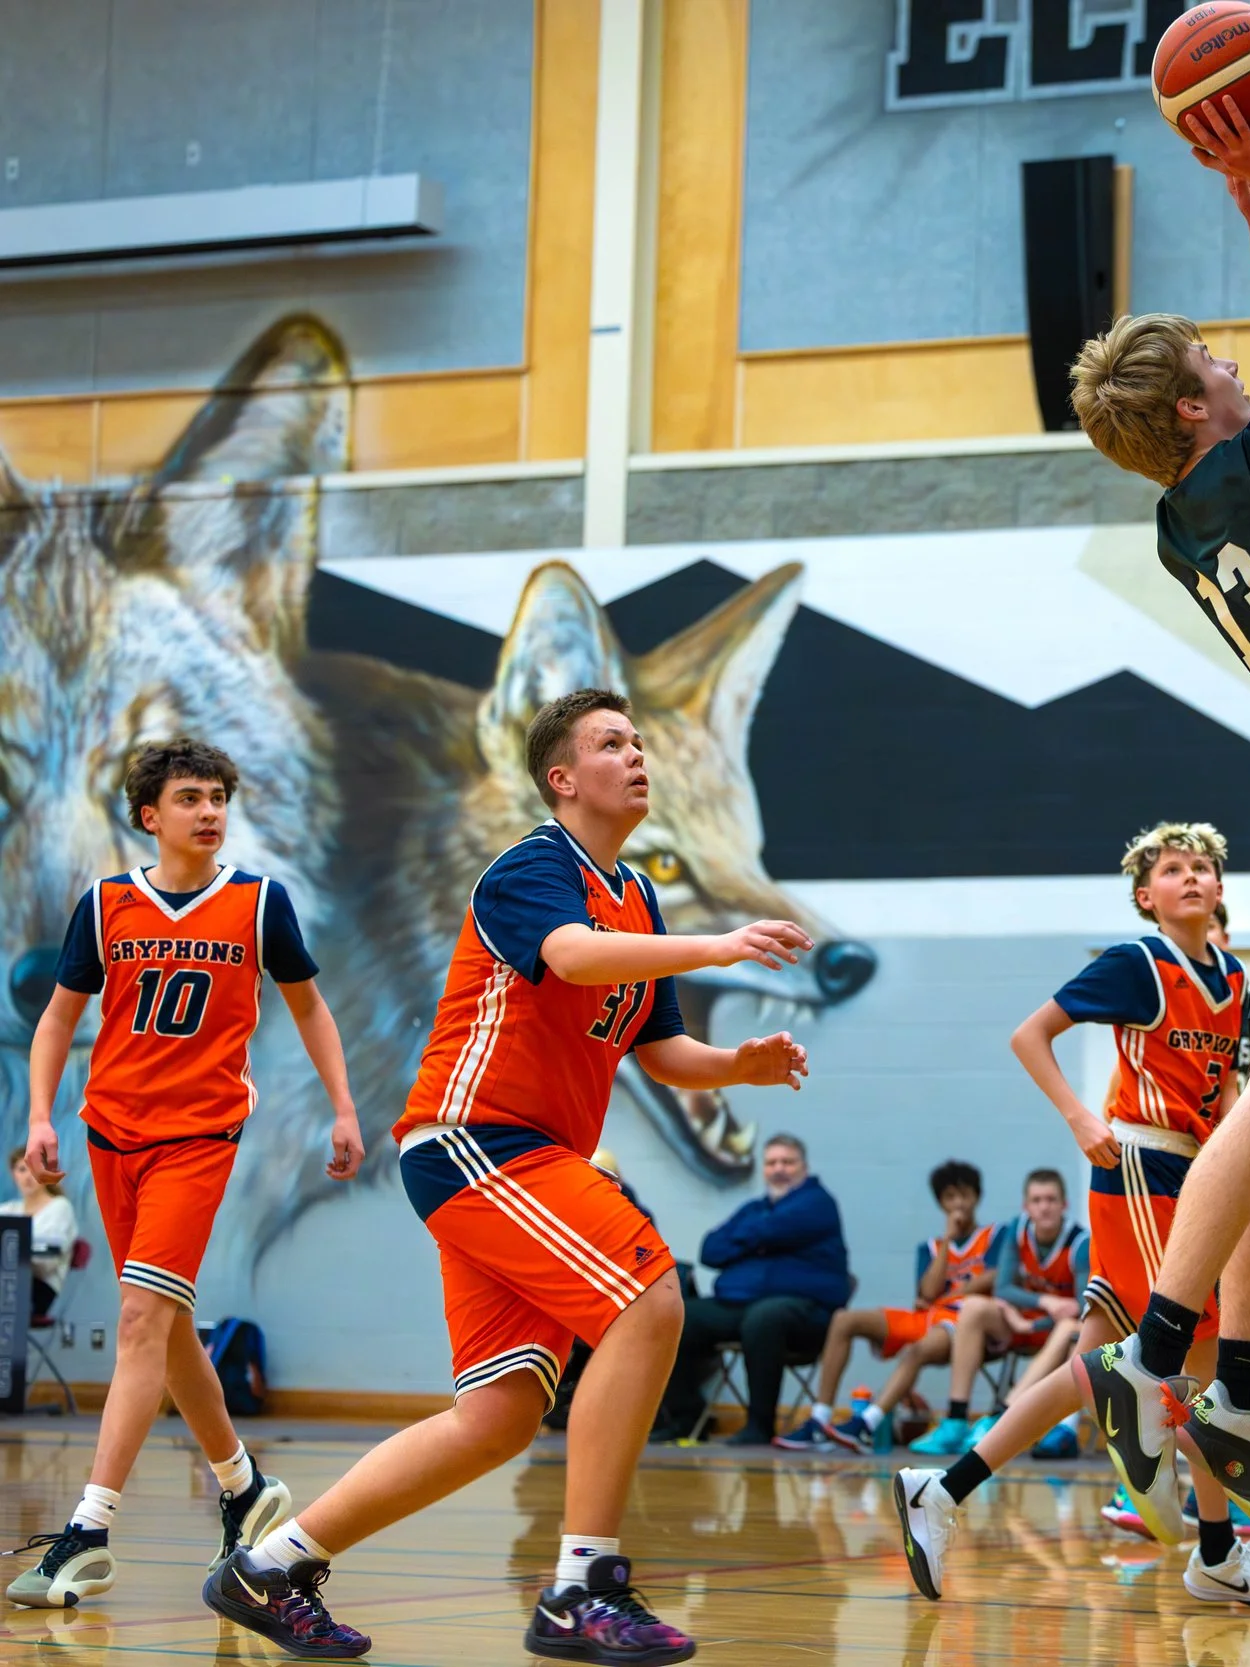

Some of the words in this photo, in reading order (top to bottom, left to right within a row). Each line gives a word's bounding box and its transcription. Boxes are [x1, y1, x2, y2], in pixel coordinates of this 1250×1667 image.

[110, 937, 245, 967] GRYPHONS
[130, 967, 213, 1039] 10
[586, 980, 648, 1048] 31
